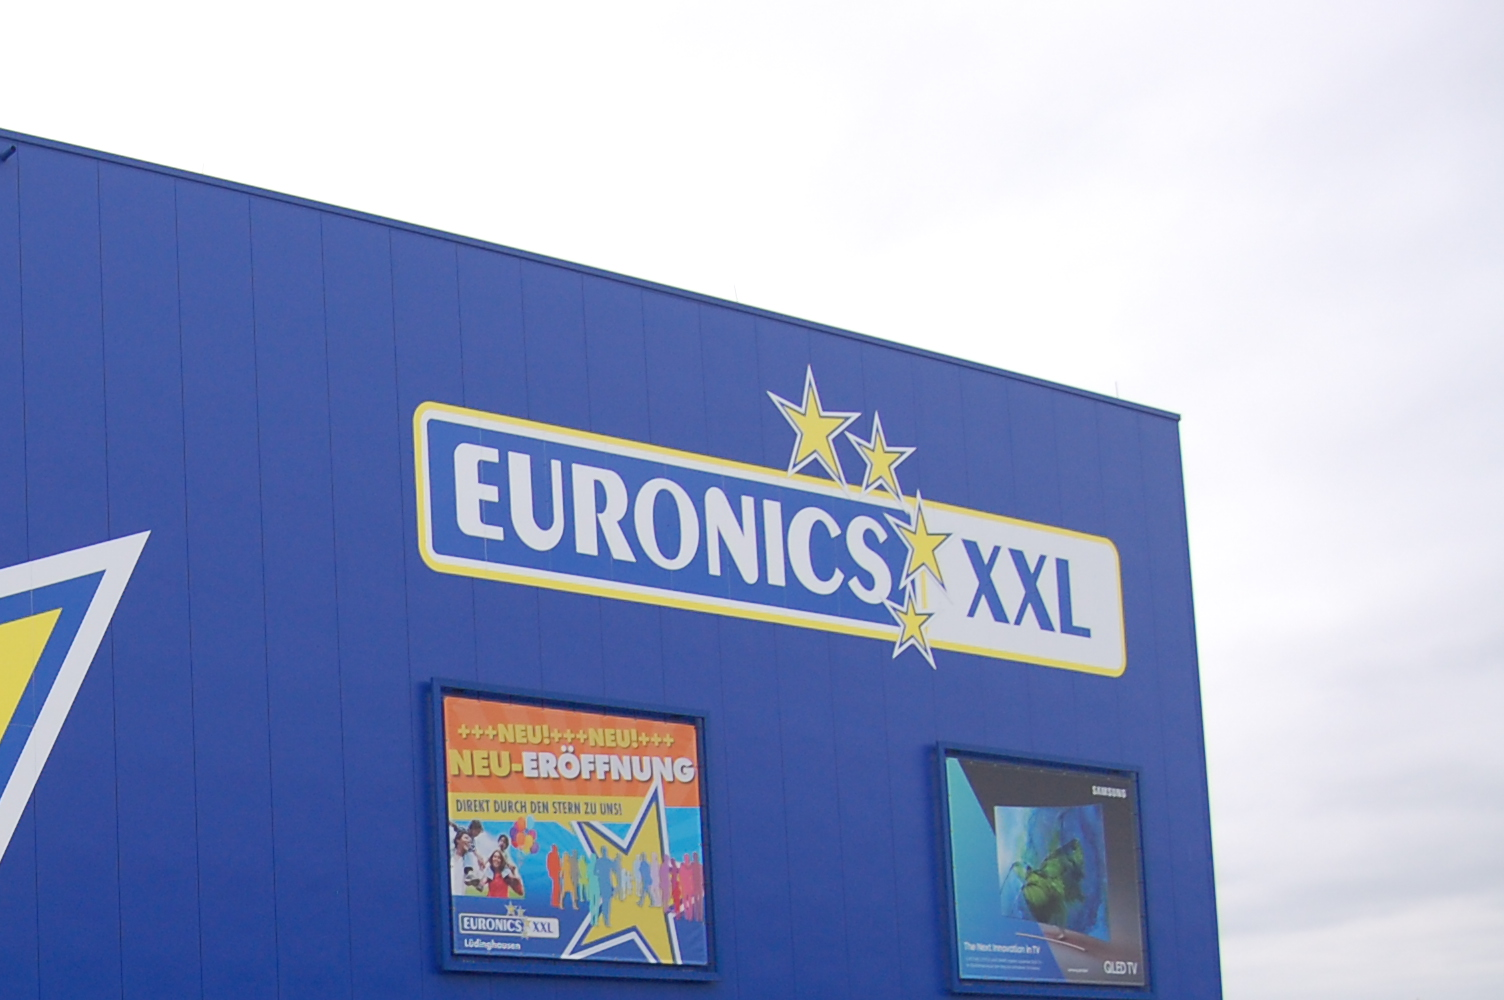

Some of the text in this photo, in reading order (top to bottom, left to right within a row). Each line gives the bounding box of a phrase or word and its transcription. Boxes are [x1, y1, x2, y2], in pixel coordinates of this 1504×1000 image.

[452, 442, 1091, 639] EURONICS XXL
[449, 745, 695, 783] NEU-ERÖFFNUNG
[1092, 785, 1126, 798] SAMSUNG
[456, 799, 623, 816] DIREKT DURCH DEN STERN ZU UNS!
[463, 916, 553, 933] EURONICS XXL
[464, 938, 521, 950] Lüdinghausen
[1103, 960, 1126, 974] QLED
[1127, 962, 1138, 974] TV
